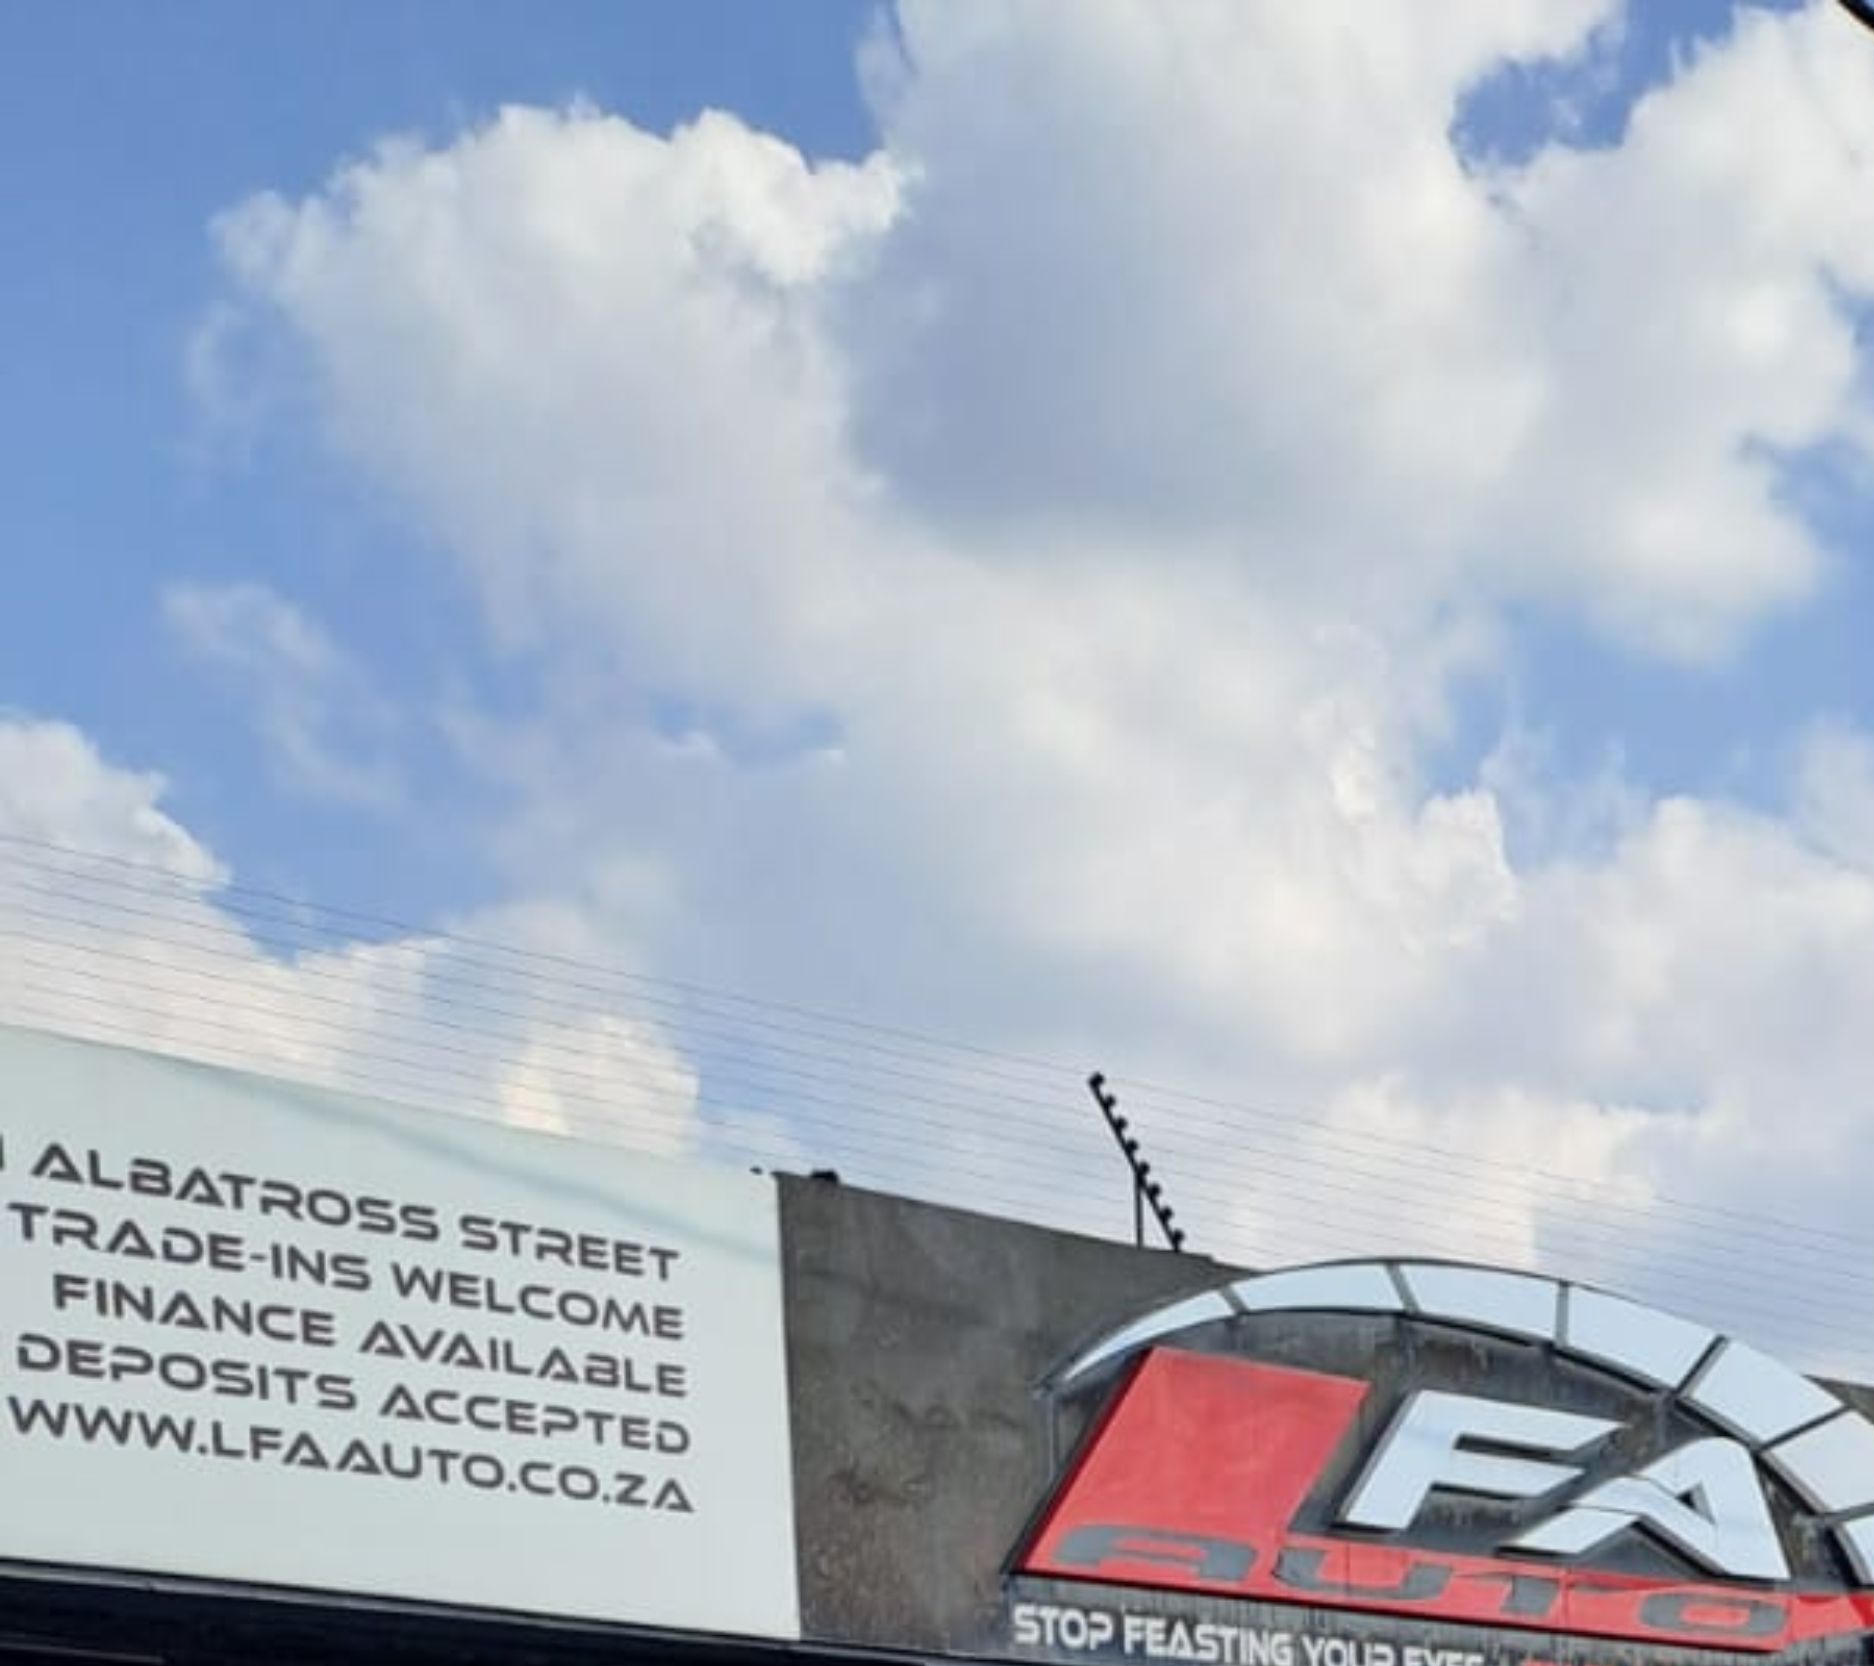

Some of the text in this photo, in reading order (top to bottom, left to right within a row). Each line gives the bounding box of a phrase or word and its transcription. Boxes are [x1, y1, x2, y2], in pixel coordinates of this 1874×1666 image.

[6, 1201, 684, 1341] TRADE-INS WELCOME
[31, 1141, 439, 1242] ALBATROSS
[459, 1214, 680, 1281] STREET
[16, 1333, 690, 1455] DEPOSITS ACCEPTED
[53, 1273, 687, 1398] FINANCE AVAILABLE
[7, 1395, 695, 1513] WWW.LFAAUTO.CO.ZA
[1012, 1604, 1114, 1652] STOP
[1052, 1523, 1791, 1642] AUTO
